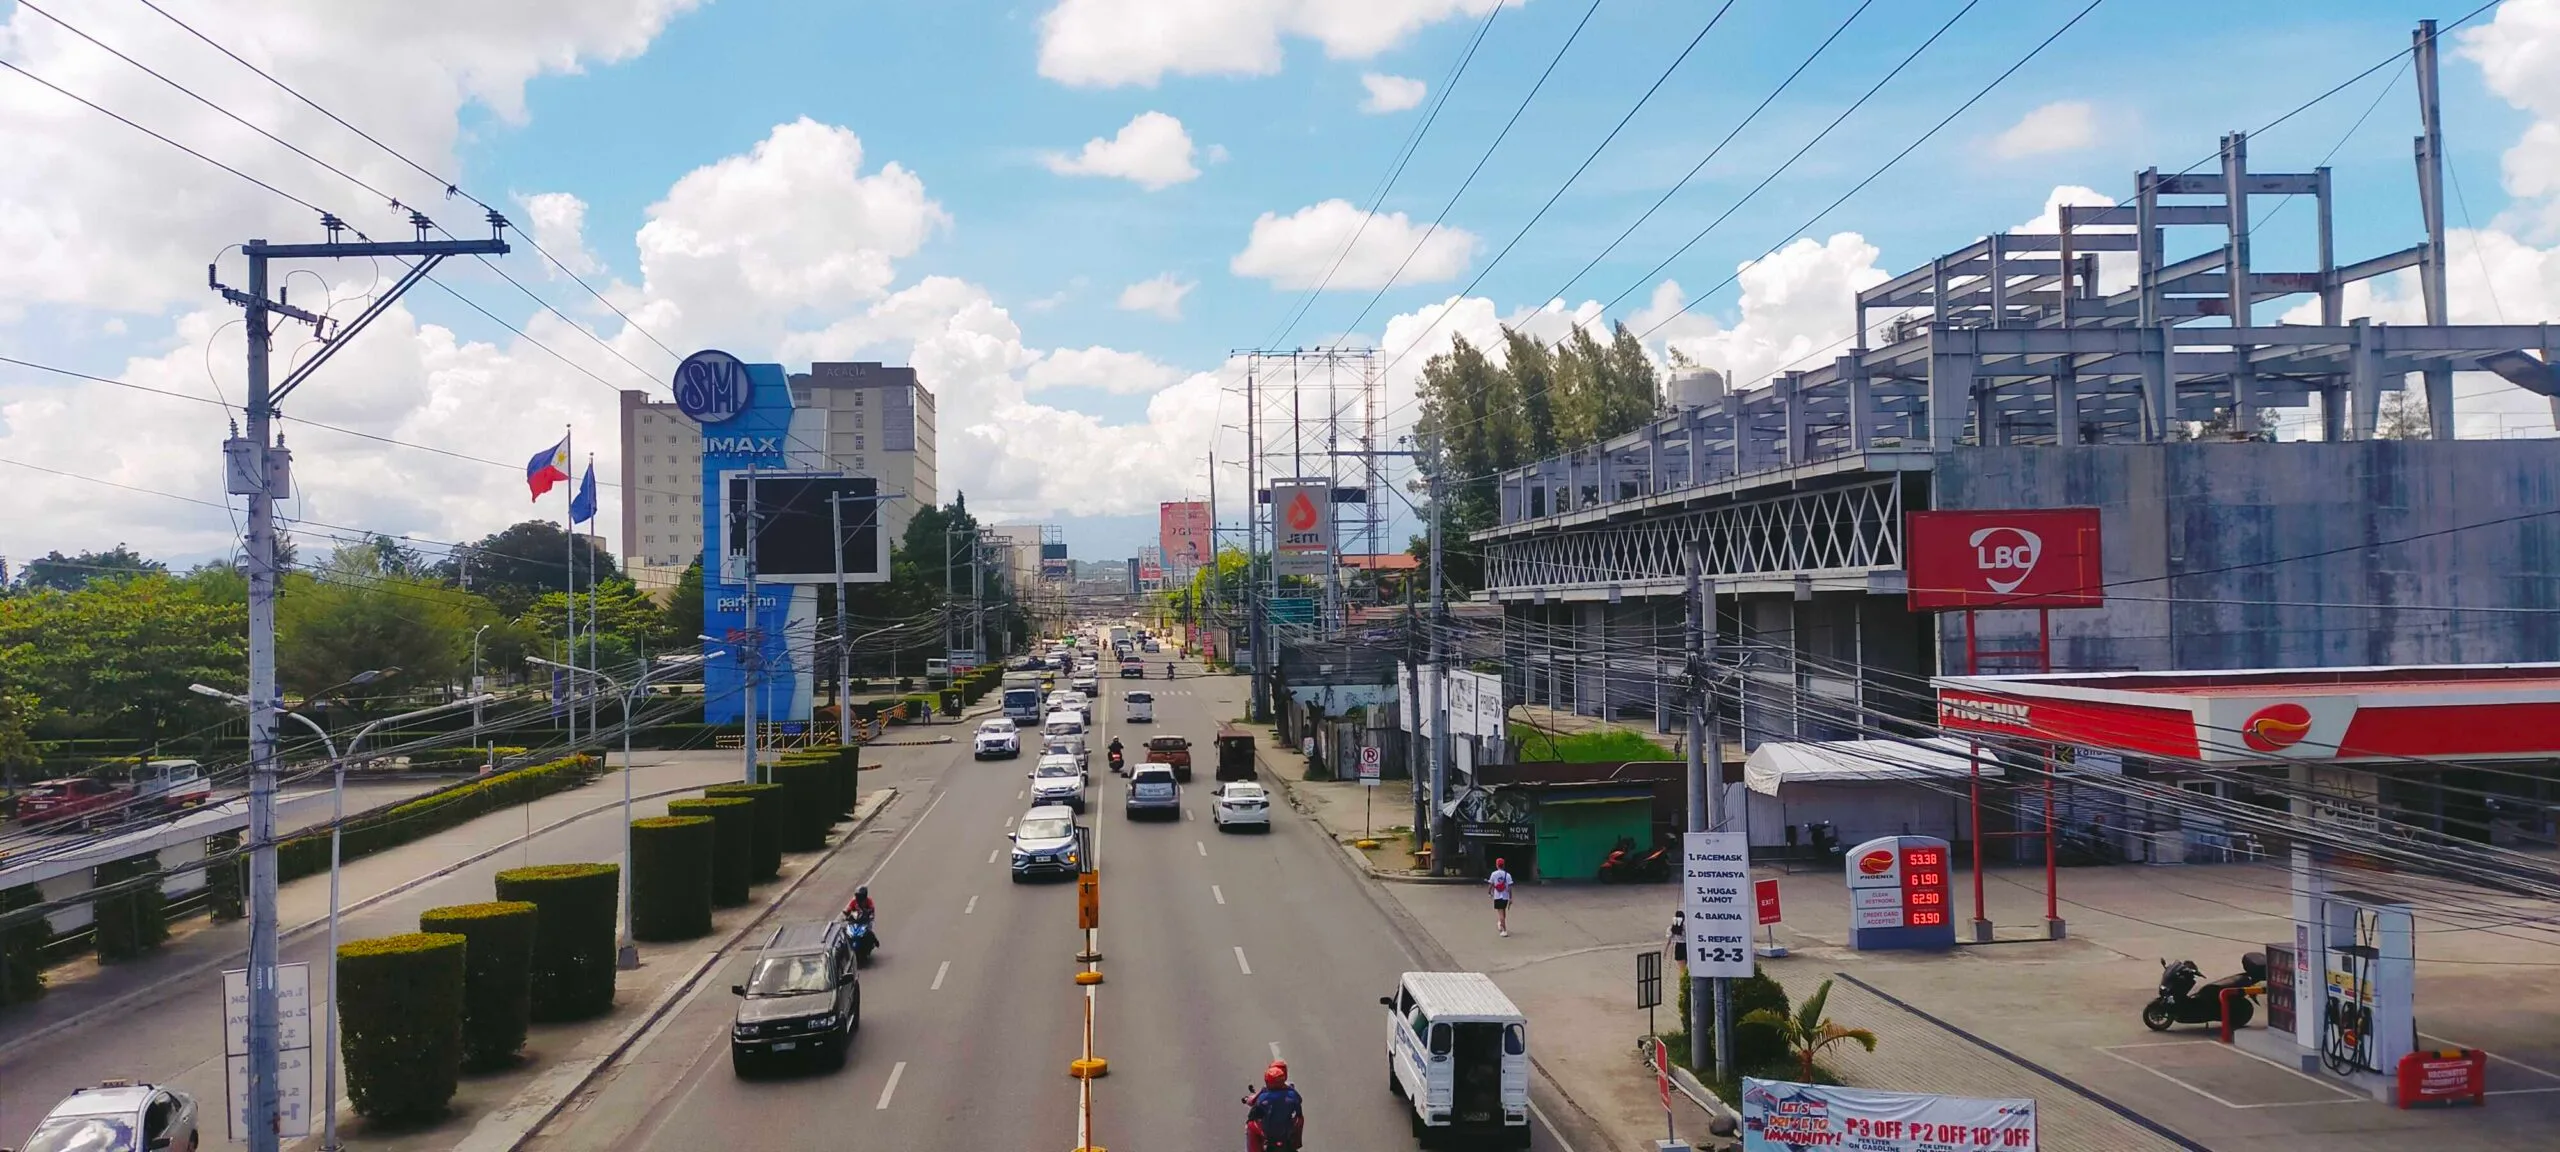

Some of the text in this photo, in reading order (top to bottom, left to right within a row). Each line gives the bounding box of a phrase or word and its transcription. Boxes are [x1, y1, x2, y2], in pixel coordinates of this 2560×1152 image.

[826, 366, 867, 377] ACACIA
[680, 359, 738, 414] SM
[702, 437, 778, 453] IMAX
[1287, 534, 1319, 544] JETTI
[1978, 545, 2031, 570] LBC
[1942, 698, 2031, 725] PHOENIX
[1688, 853, 1742, 862] 1. FACEMASK
[1910, 854, 1937, 865] 53.38
[1702, 896, 1733, 904] KAMOT
[1912, 893, 1939, 904] 62.90
[1695, 912, 1704, 920] 4.
[1913, 913, 1940, 925] 63.90
[1698, 947, 1744, 962] 1-2-3
[1780, 1102, 1810, 1114] LET'S
[1812, 1117, 1829, 1130] TO
[1763, 1128, 1843, 1146] IMMUNITY!
[1874, 1119, 1903, 1140] OFF
[1938, 1124, 1967, 1144] OFF
[2003, 1127, 2030, 1147] OFF
[1862, 1143, 1901, 1152] GASOLINE
